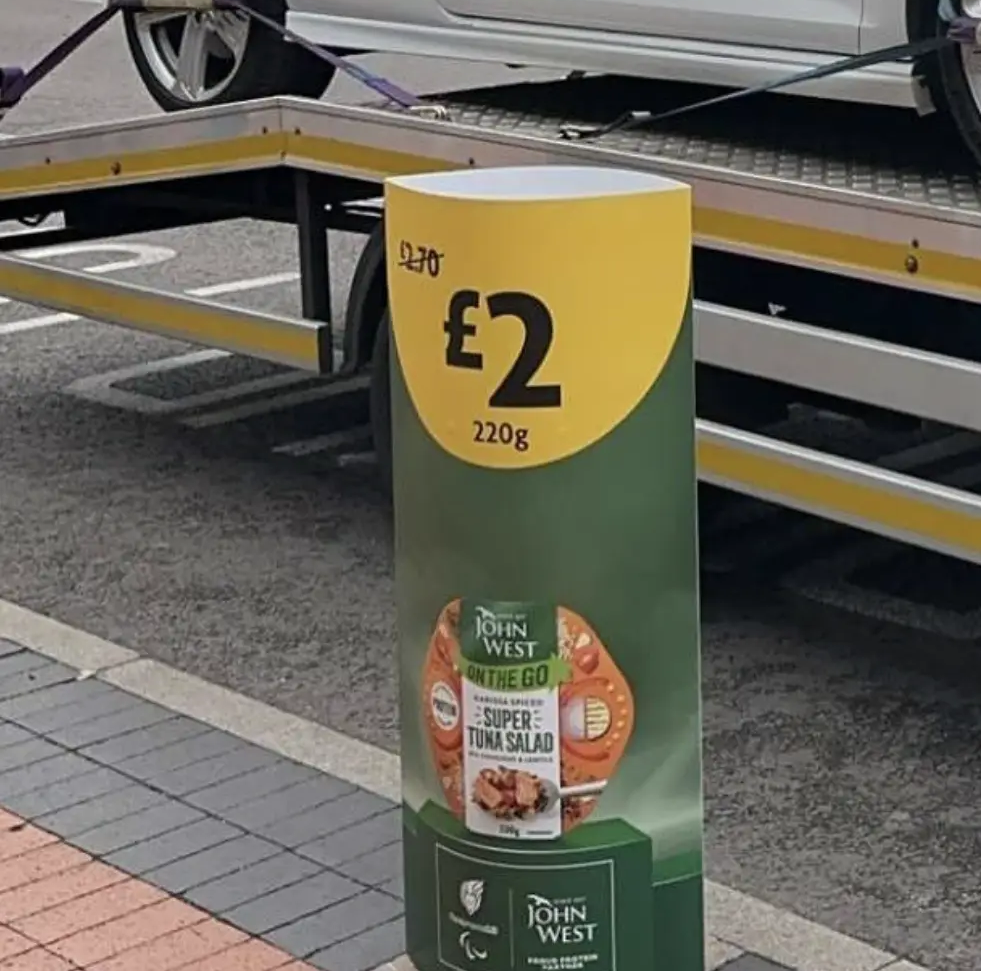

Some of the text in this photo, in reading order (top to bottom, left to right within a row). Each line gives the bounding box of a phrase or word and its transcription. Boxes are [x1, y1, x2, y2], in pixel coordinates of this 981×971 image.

[444, 289, 561, 408] £2
[473, 420, 529, 452] 220g
[476, 615, 528, 640] JOHN
[483, 636, 539, 659] WEST
[467, 664, 549, 689] ON THE GO
[484, 706, 532, 731] SUPER
[467, 725, 554, 754] TUNA SALAD
[527, 904, 587, 929] JOHN
[535, 923, 598, 944] WEST
